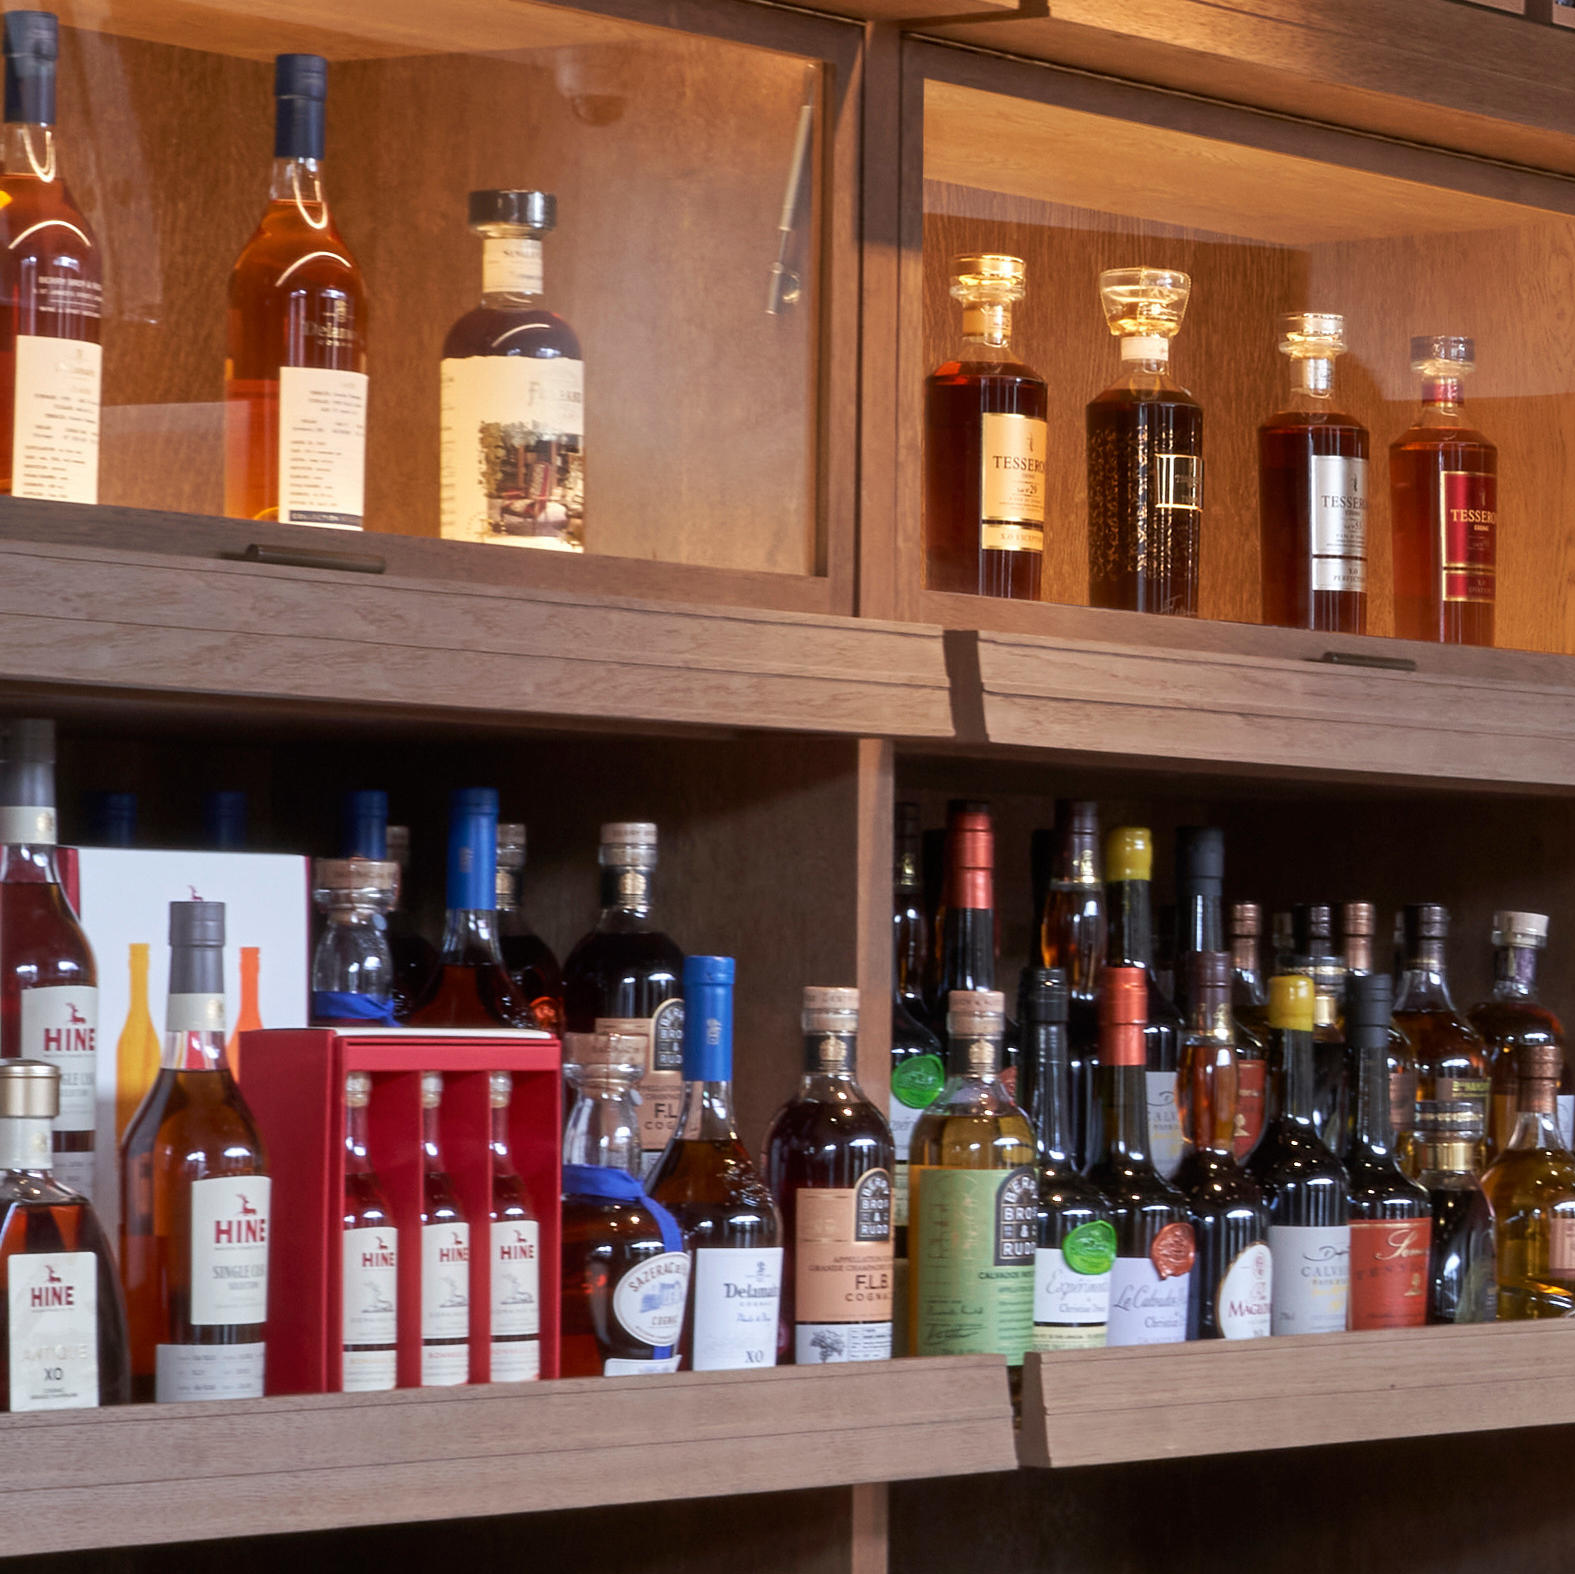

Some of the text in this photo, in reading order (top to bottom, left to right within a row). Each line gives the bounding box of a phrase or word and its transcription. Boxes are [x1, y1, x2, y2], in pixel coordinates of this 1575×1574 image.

[44, 1028, 96, 1052] HINE
[1003, 1206, 1038, 1221] BROS
[214, 1218, 267, 1245] HINE
[860, 1224, 889, 1236] RUDD
[1020, 1225, 1029, 1238] &
[362, 1252, 395, 1268] HINE
[439, 1247, 469, 1263] HINE
[500, 1244, 535, 1261] HINE
[31, 1285, 75, 1308] HINE
[744, 1349, 764, 1363] XO
[43, 1367, 64, 1382] XO
